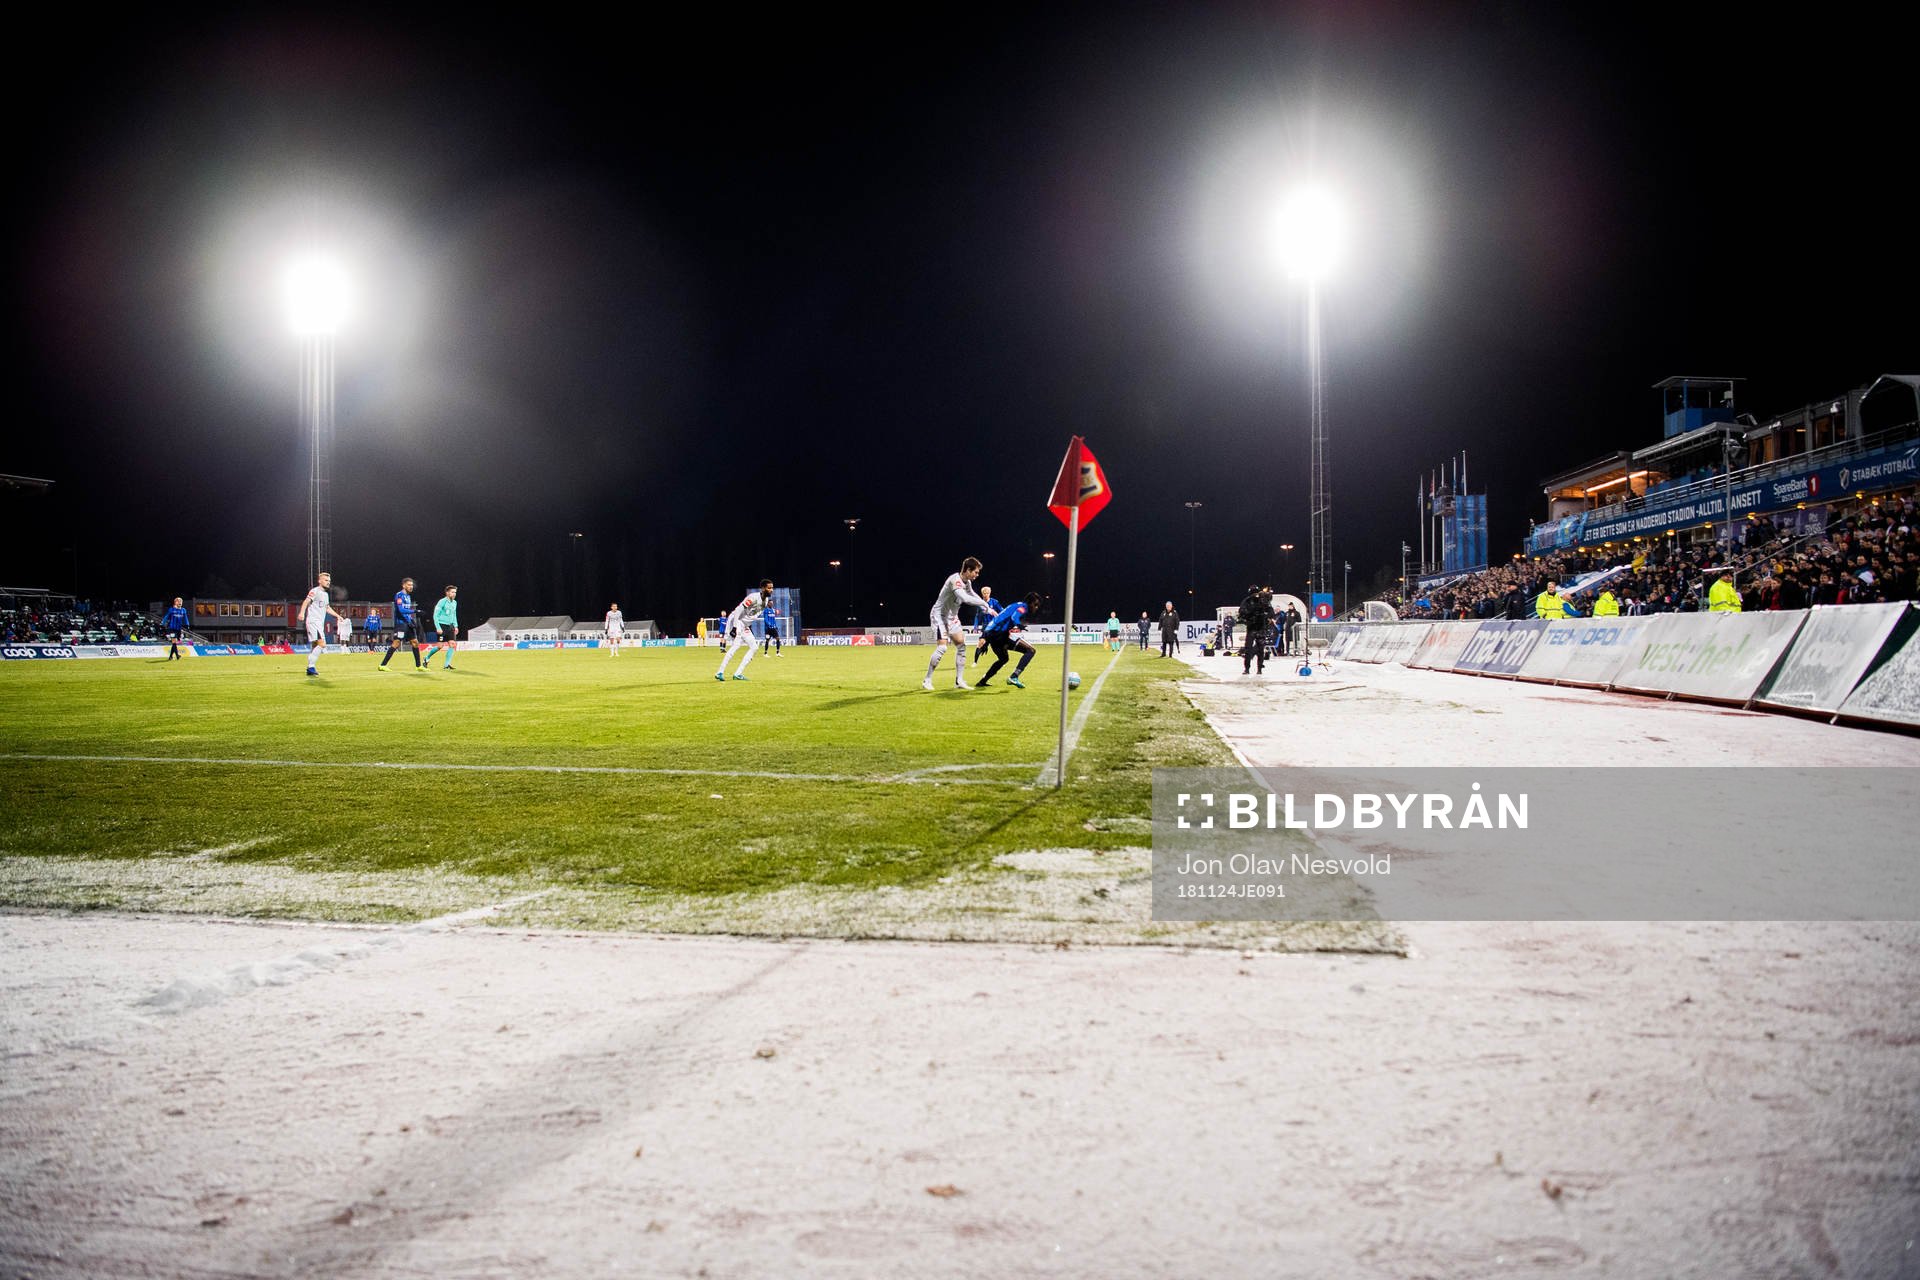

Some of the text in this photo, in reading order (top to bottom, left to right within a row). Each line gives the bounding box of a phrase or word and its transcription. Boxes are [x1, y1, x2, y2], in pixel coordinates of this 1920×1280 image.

[1852, 455, 1917, 482] STABÆK FOTBALL
[1773, 477, 1817, 497] SpareBank 1
[1593, 527, 1600, 539] ER
[1600, 525, 1616, 539] DETTE
[1616, 521, 1627, 536] SOM
[1636, 512, 1667, 531] NADDERUD
[1667, 505, 1696, 524] STADION
[1320, 605, 1327, 616] 1
[808, 636, 852, 646] macron
[1460, 628, 1541, 667] macron
[4, 647, 73, 658] coop coop
